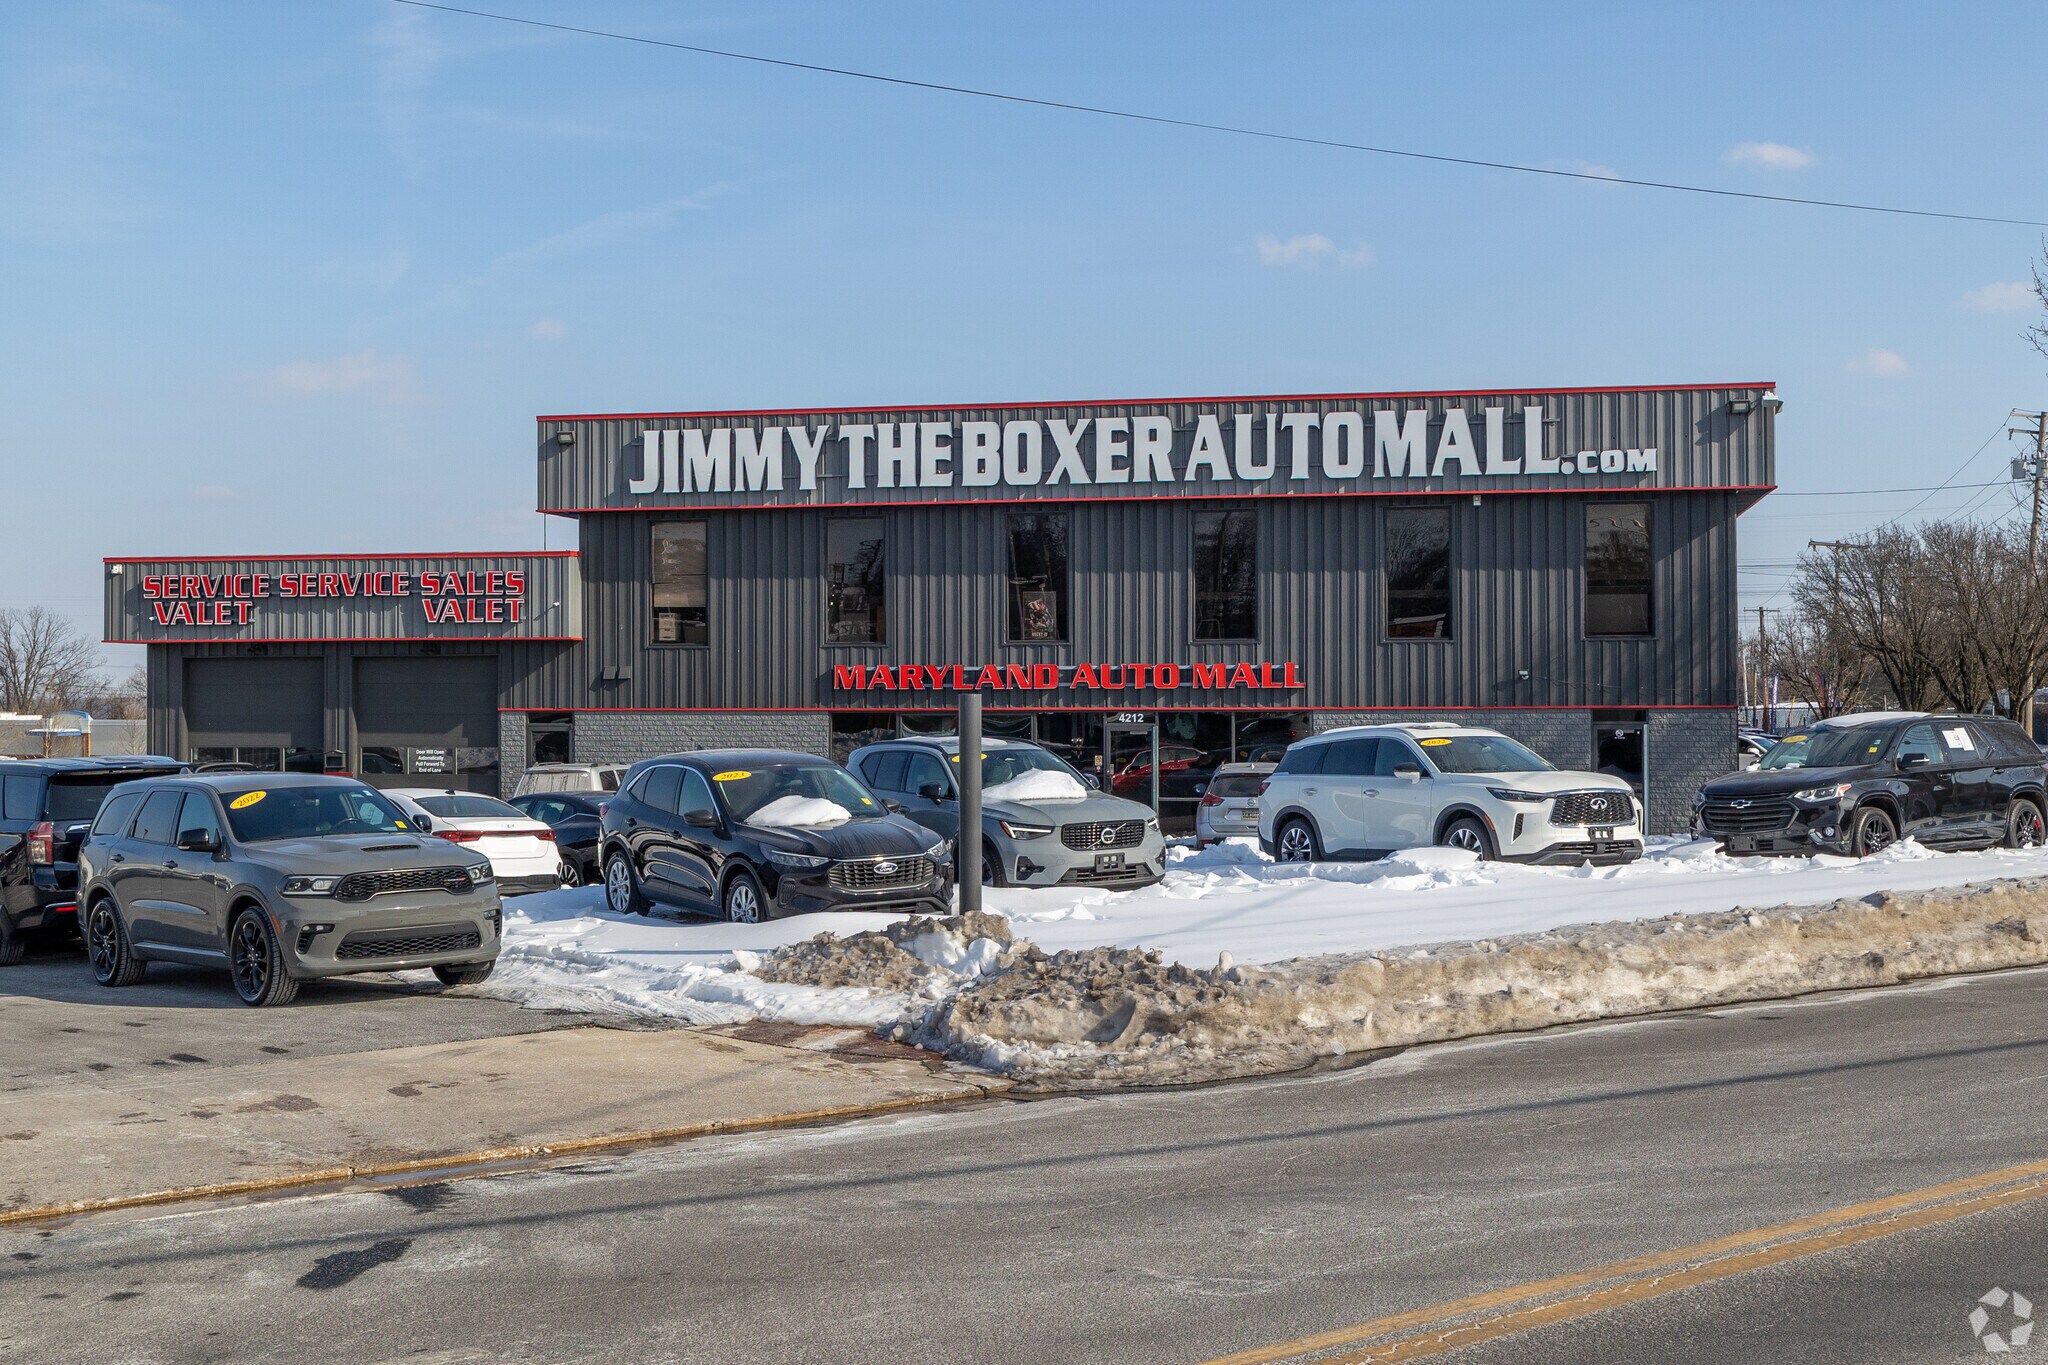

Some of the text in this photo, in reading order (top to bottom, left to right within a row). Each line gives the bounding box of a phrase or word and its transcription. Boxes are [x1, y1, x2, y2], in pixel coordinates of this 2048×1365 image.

[142, 570, 526, 599] SERVICE SERVICE SALES
[152, 600, 254, 626] VALET
[421, 598, 525, 624] VALET
[834, 661, 1307, 690] MARYLAND AUTO MALL
[1118, 713, 1144, 723] 4212
[237, 792, 261, 806] 2022
